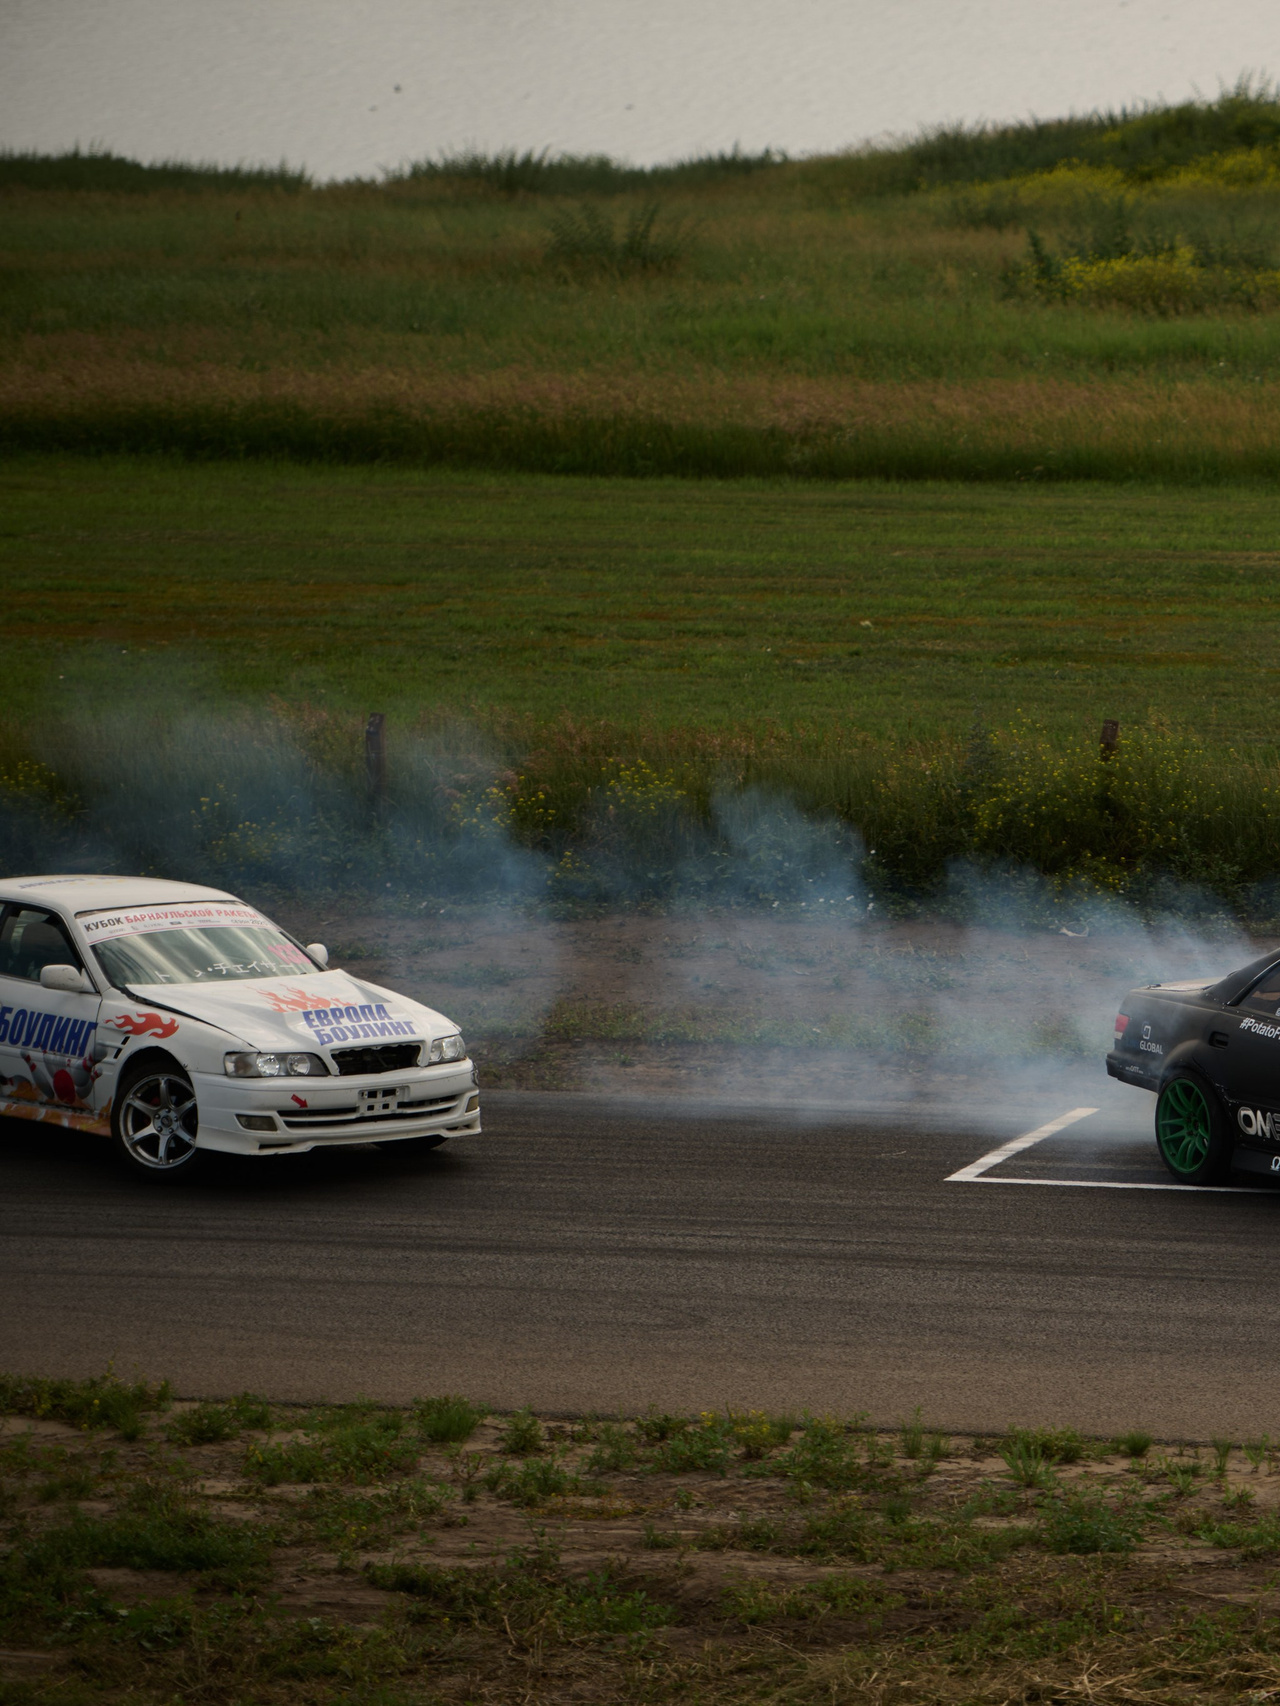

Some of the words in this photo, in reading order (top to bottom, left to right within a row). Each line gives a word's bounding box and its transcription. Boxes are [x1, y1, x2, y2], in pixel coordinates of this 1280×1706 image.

[83, 916, 123, 933] КУБОК
[123, 908, 214, 924] БАРНАУЛЬСКОЙ
[302, 1003, 393, 1029] ЕВРОПА
[0, 1006, 98, 1057] БОУЛИНГ
[313, 1020, 417, 1046] БОУЛИНГ
[1139, 1040, 1163, 1055] GLOBAL
